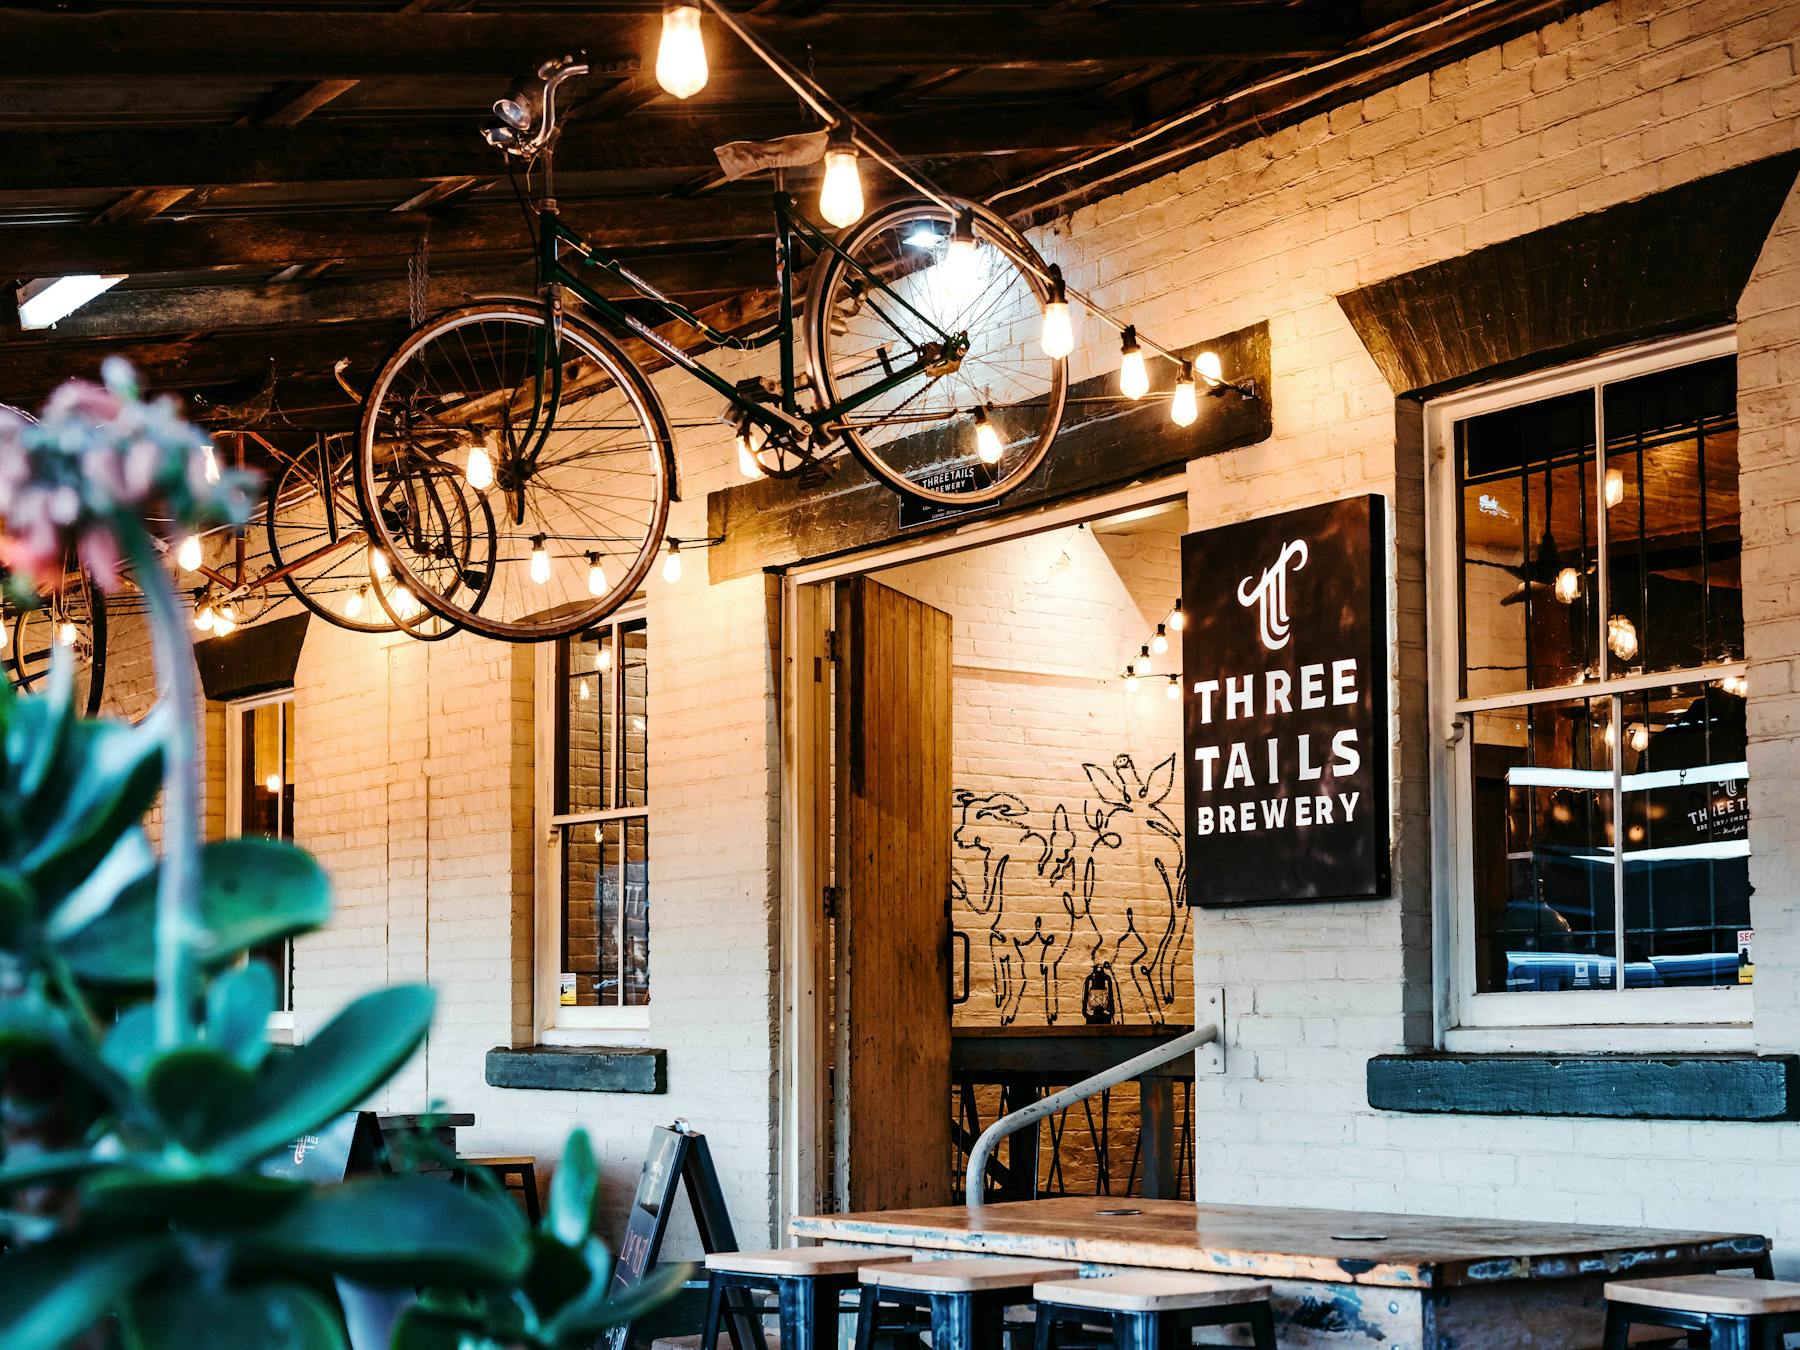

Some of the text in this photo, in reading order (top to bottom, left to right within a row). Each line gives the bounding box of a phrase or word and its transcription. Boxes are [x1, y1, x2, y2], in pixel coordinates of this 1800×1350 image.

[922, 467, 974, 488] THREE TAILS
[1193, 658, 1359, 724] THREE
[1194, 728, 1361, 792] TAILS
[1197, 791, 1360, 836] BREWERY
[1696, 820, 1724, 832] BREERY
